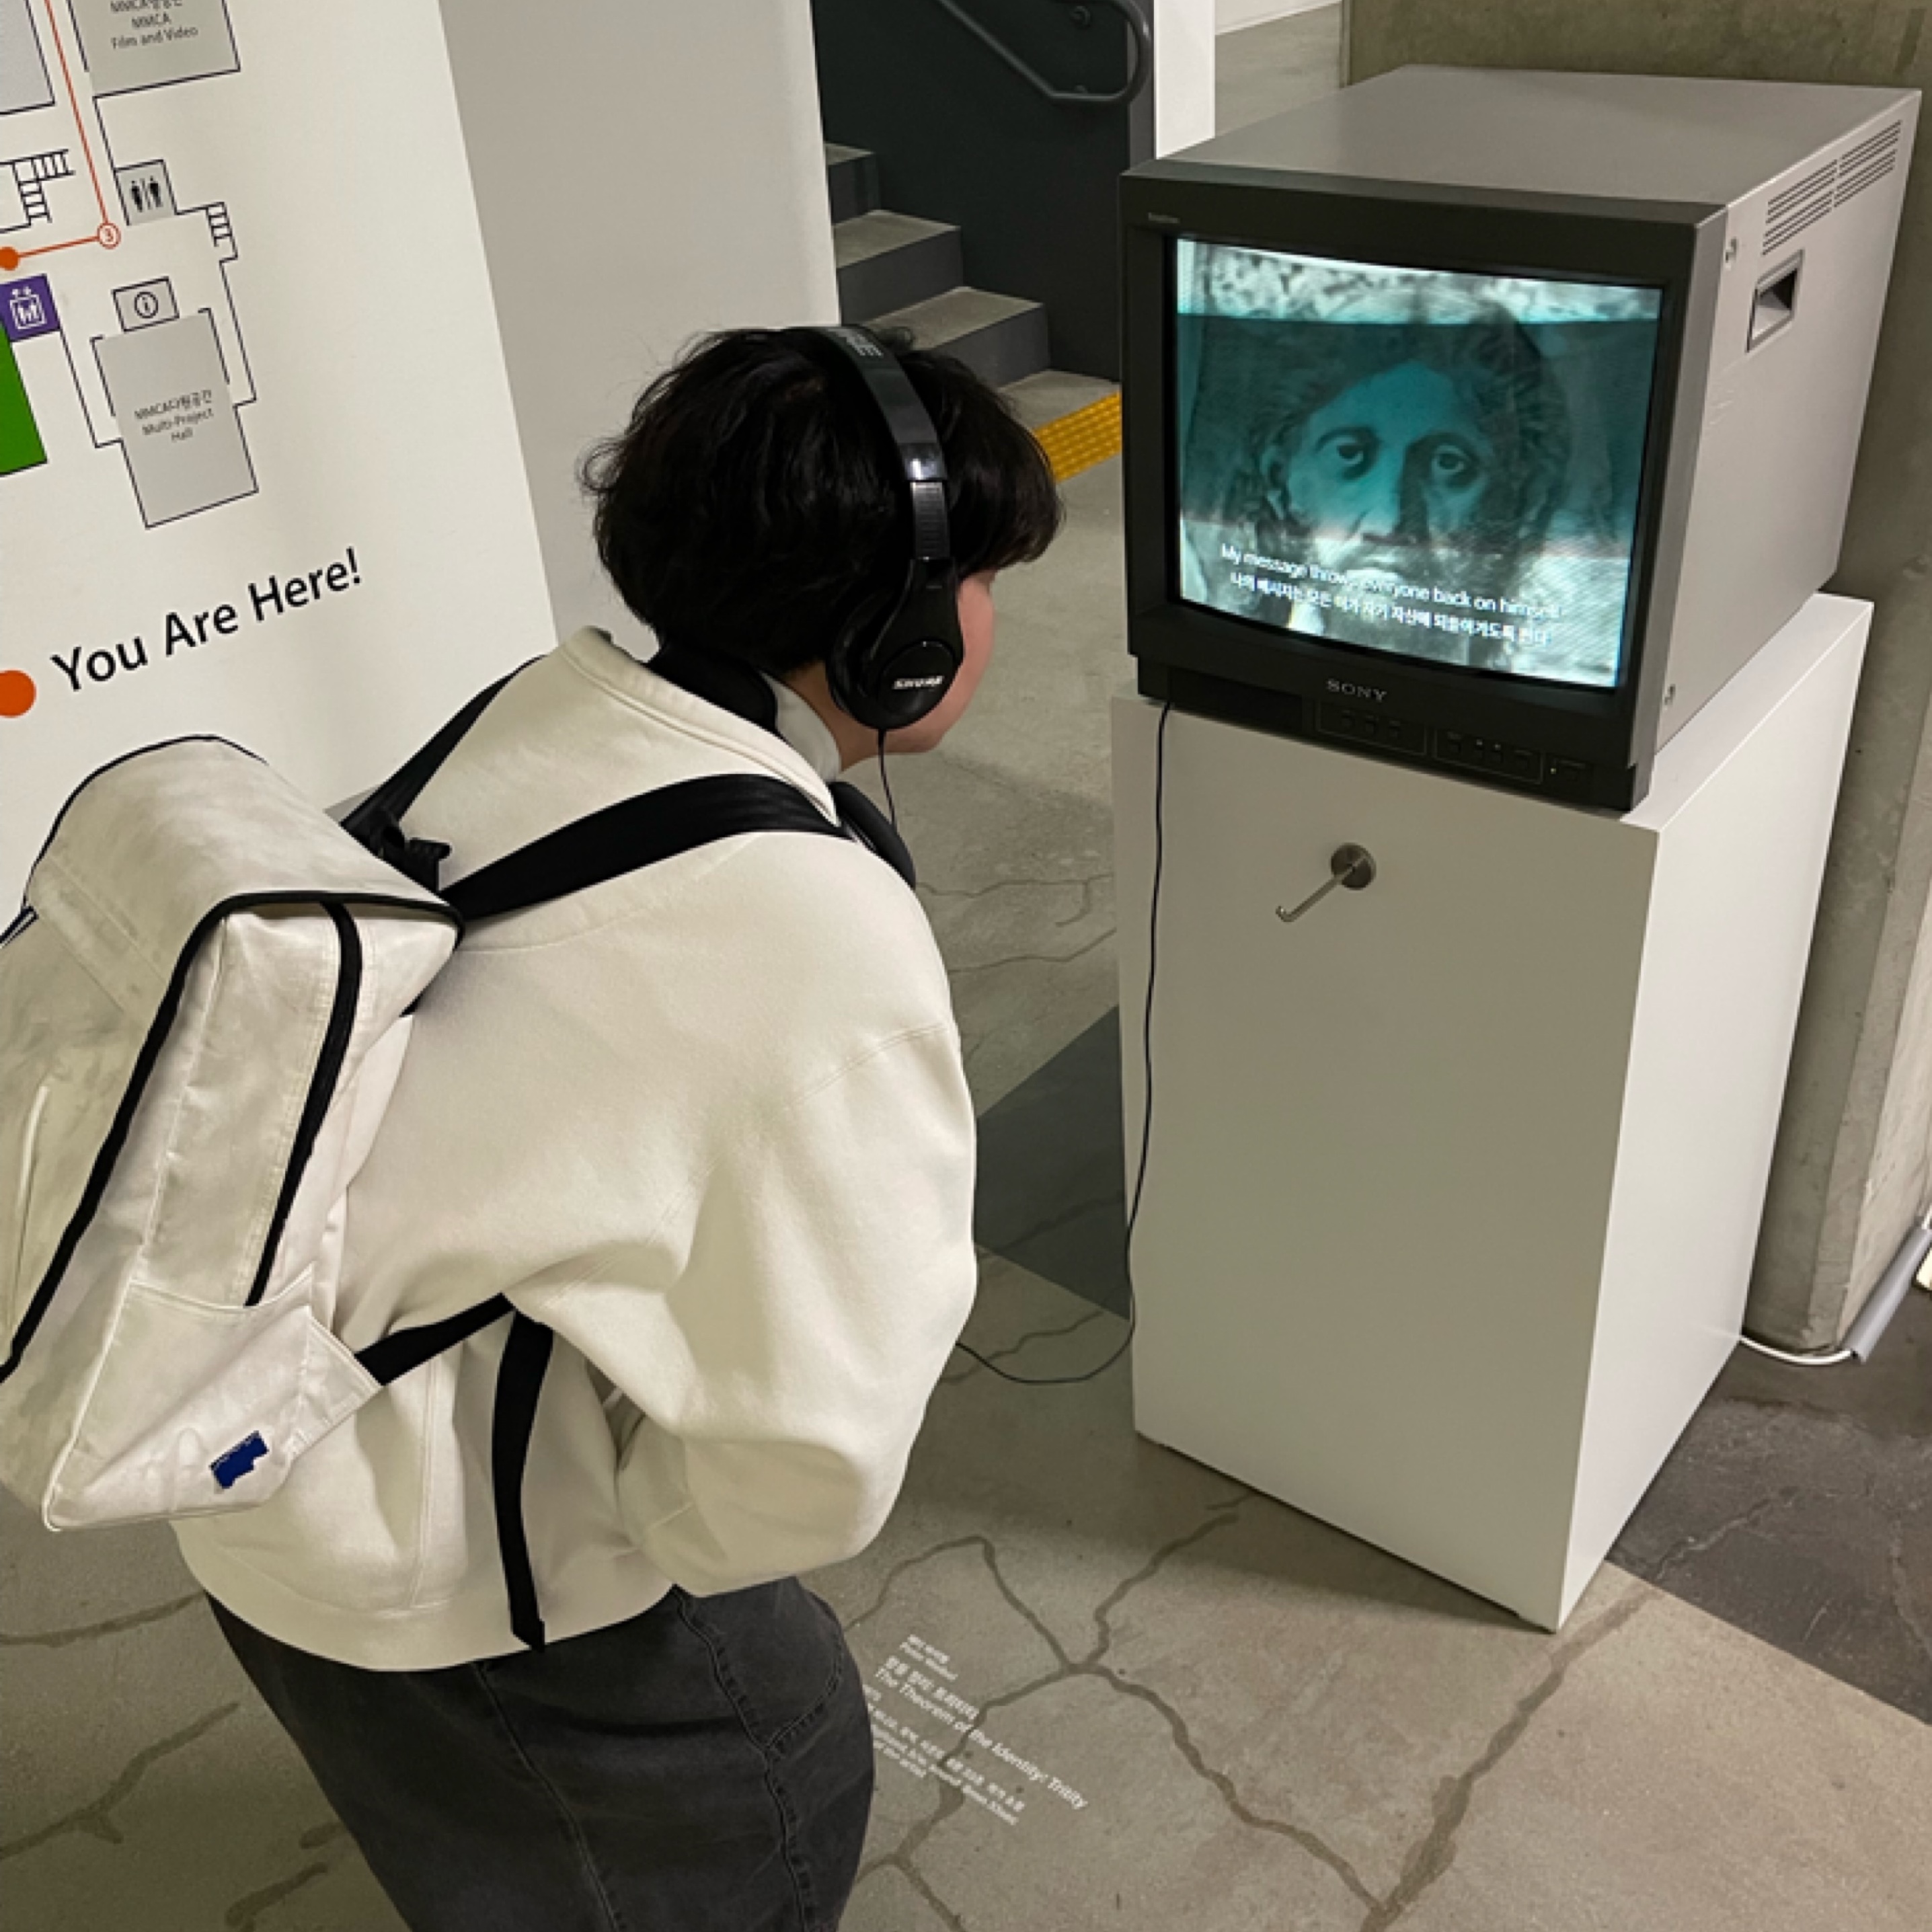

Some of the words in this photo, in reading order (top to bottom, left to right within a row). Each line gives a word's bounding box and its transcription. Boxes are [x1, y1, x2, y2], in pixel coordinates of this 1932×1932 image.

[130, 12, 172, 28] MMCA
[110, 36, 138, 50] Film
[141, 30, 163, 46] and
[163, 25, 200, 41] Video
[141, 408, 215, 436] Multi-Project
[171, 426, 194, 443] Hall
[1221, 542, 1242, 566] My
[1243, 552, 1309, 579] message
[1433, 585, 1472, 608] back
[1473, 596, 1498, 613] on
[50, 635, 149, 692] You
[165, 604, 239, 658] Are
[247, 545, 361, 623] Here!
[1325, 678, 1388, 703] SONY
[876, 1668, 898, 1687] The
[954, 1721, 974, 1734] of
[969, 1730, 992, 1748] the
